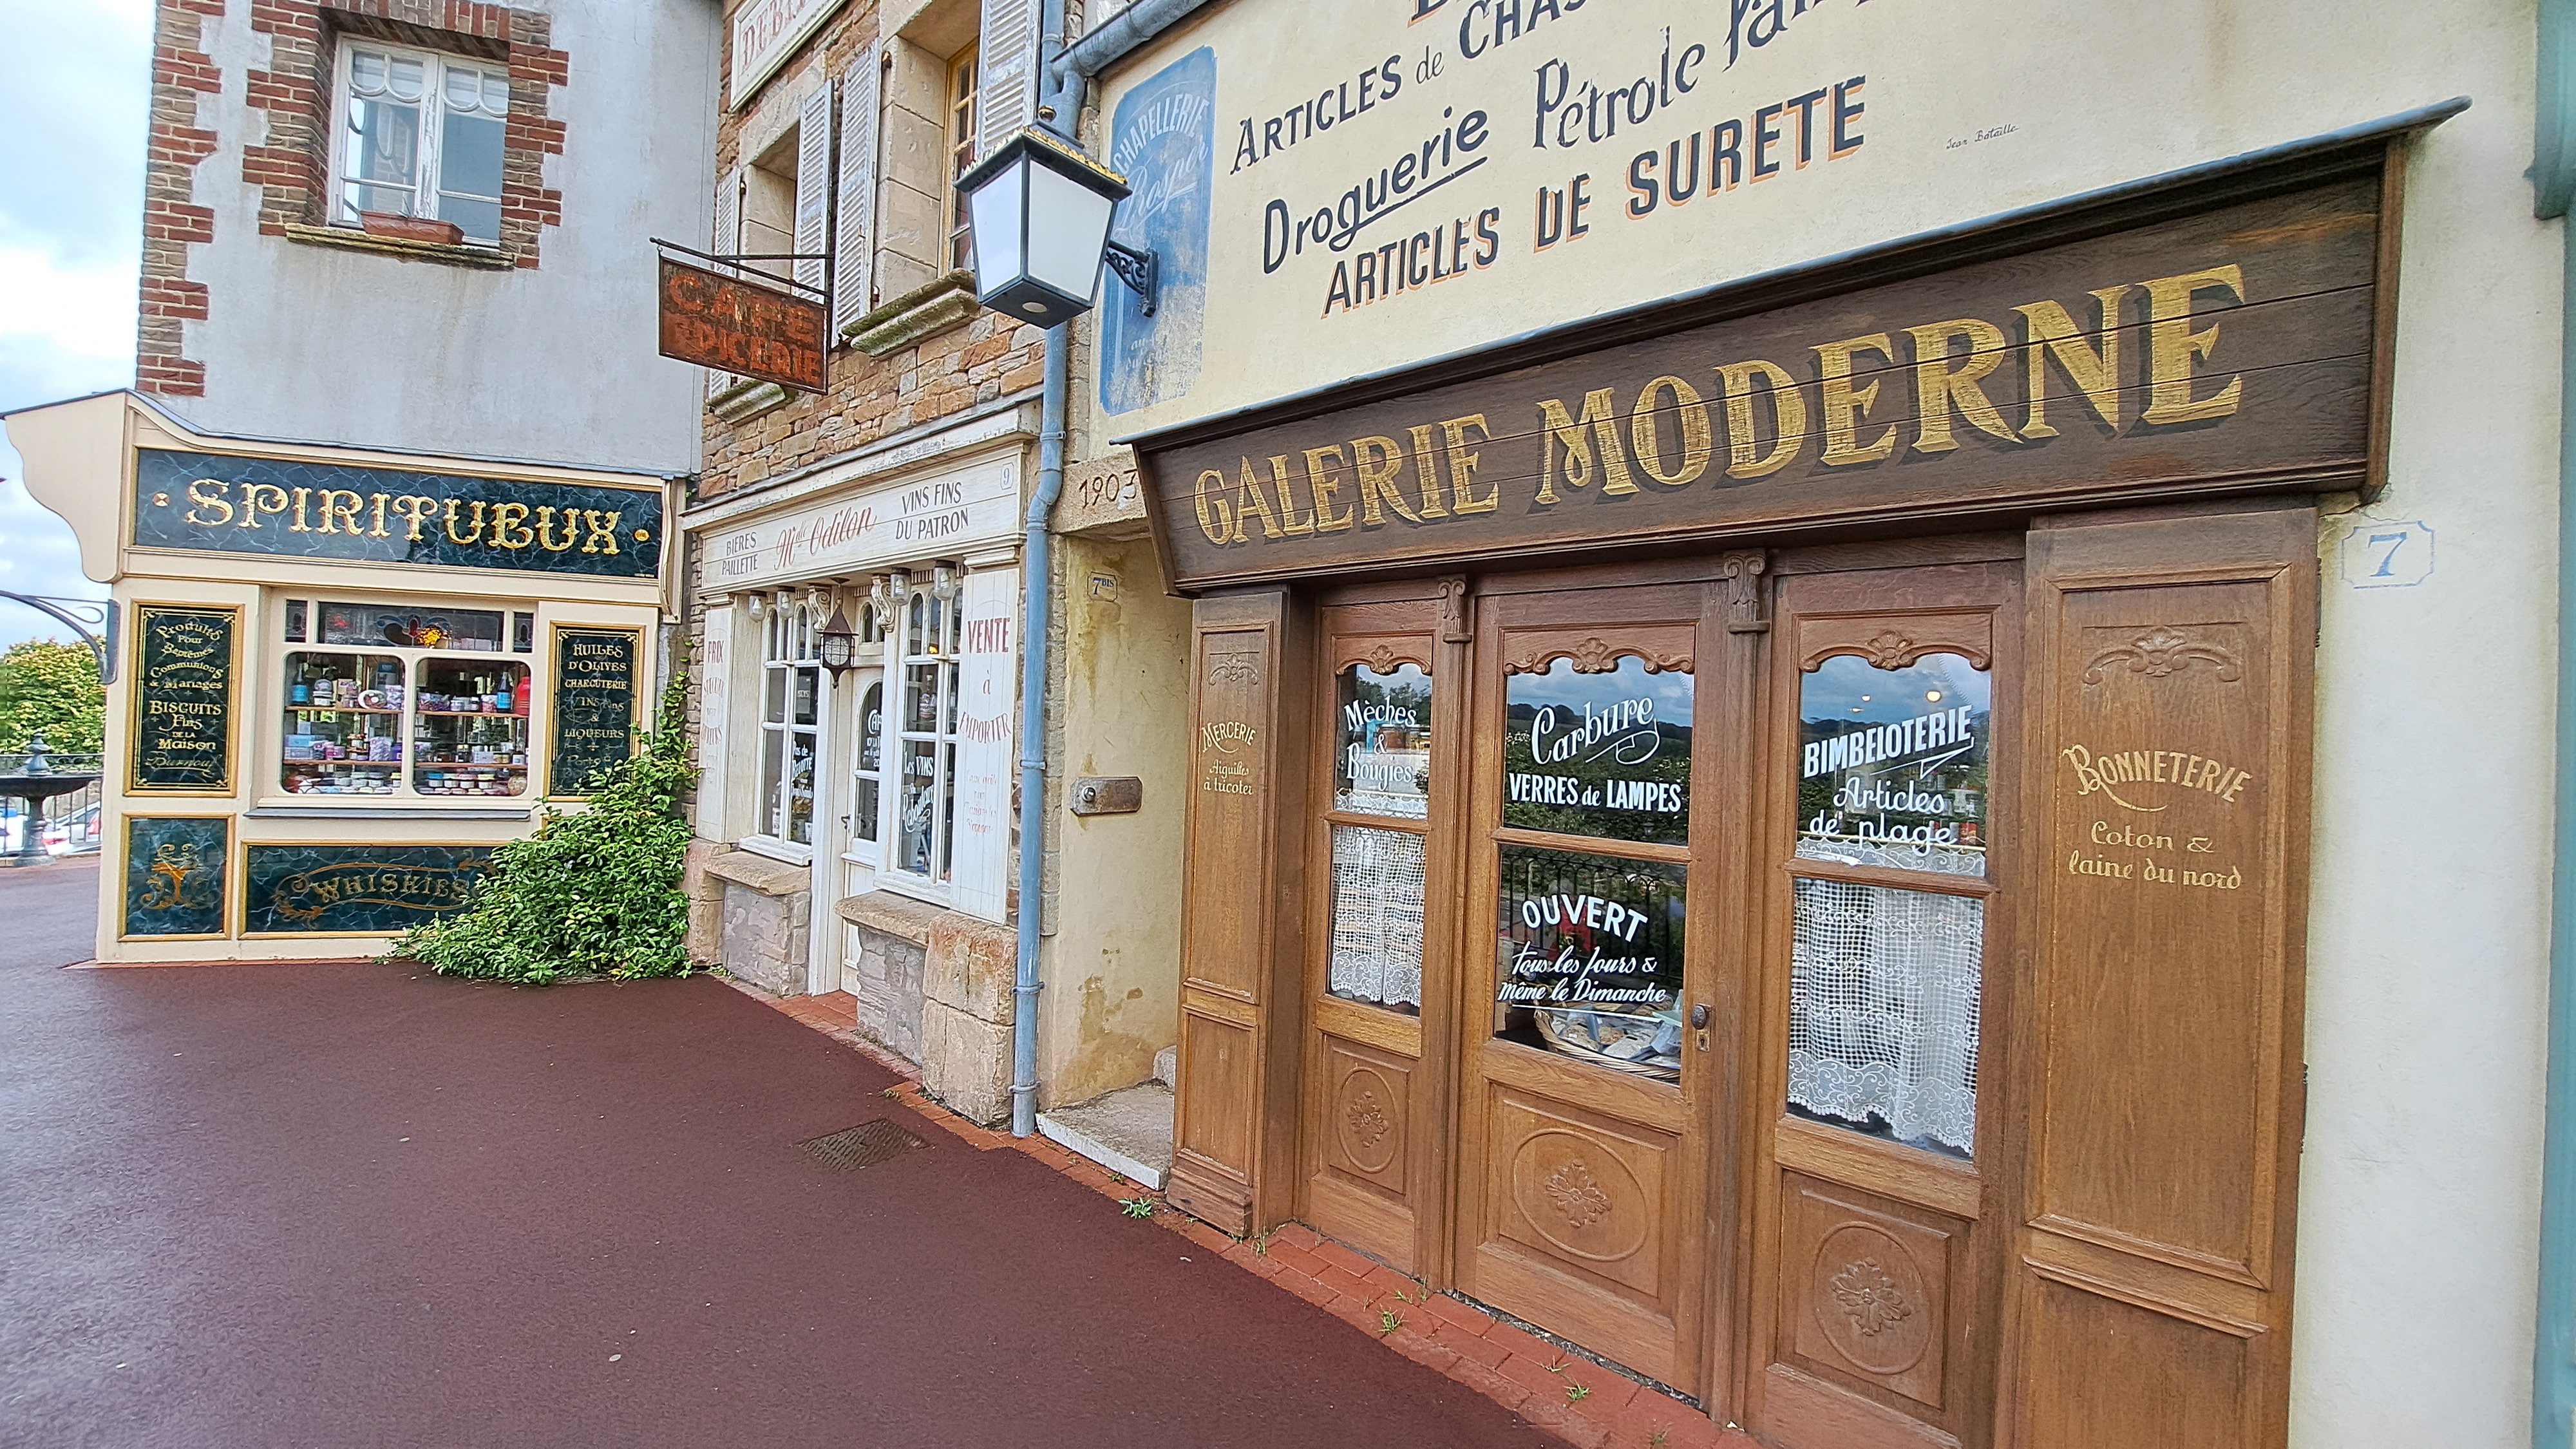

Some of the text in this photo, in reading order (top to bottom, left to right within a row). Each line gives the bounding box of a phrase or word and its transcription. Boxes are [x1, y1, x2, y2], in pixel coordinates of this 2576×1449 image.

[1230, 54, 1402, 175] ARTICLES
[1416, 45, 1444, 84] de
[1113, 92, 1210, 175] CHAPELLERIE
[1975, 123, 2020, 142] Bataille
[1263, 106, 1489, 275] Droguerie
[1532, 26, 1705, 149] Pétrole
[1321, 75, 1866, 319] ARTICLES DE SURETE
[1193, 263, 2246, 548] GALERIE MODERNE
[1003, 466, 1010, 485] 9
[1079, 469, 1137, 509] 1903
[902, 481, 962, 515] VINS FINS
[185, 478, 622, 556] SPIRITUEUX
[810, 506, 878, 556] Odilon
[895, 507, 969, 541] DU PATRON
[721, 554, 759, 576] PAILLETTE
[2367, 531, 2408, 577] 7
[156, 621, 224, 641] Produits
[178, 634, 204, 645] Pour
[967, 618, 1010, 654] VENTE
[567, 659, 627, 672] D'OLIVES
[573, 644, 623, 658] HUILES
[149, 661, 224, 679] Communions
[164, 679, 223, 690] Mariages
[564, 679, 627, 690] CHARCUTERIE
[983, 670, 990, 695] à
[149, 700, 222, 715] BISCUITS
[591, 714, 599, 722] &
[1343, 695, 1417, 732] Mèches
[157, 738, 216, 750] Maison
[564, 729, 625, 740] LIQUEURS
[959, 712, 1011, 744] EMPORTER
[1202, 721, 1256, 753] MERCERIE
[1531, 697, 1655, 766] Carbure
[1804, 704, 1973, 779] BIMBELOTERIE
[801, 744, 809, 757] de
[1373, 734, 1387, 755] &
[915, 755, 934, 776] VINS
[1209, 759, 1249, 779] Aiguilles
[1346, 744, 1413, 791] Bougies
[2062, 744, 2253, 810] BONNETERIE
[1204, 777, 1253, 795] à tricoter
[1509, 772, 1682, 813] VERRES de LAMPES
[1833, 776, 1945, 813] Articles
[1810, 810, 1958, 857] de plage
[2091, 820, 2215, 853] Coton &
[2069, 850, 2242, 889] laine du nord
[310, 873, 469, 902] WHISKIES
[1522, 894, 1648, 942] OUVERT
[1548, 945, 1580, 974] les
[1642, 957, 1657, 973] &
[1548, 978, 1569, 1001] le
[1572, 978, 1667, 1003] Dimanche
